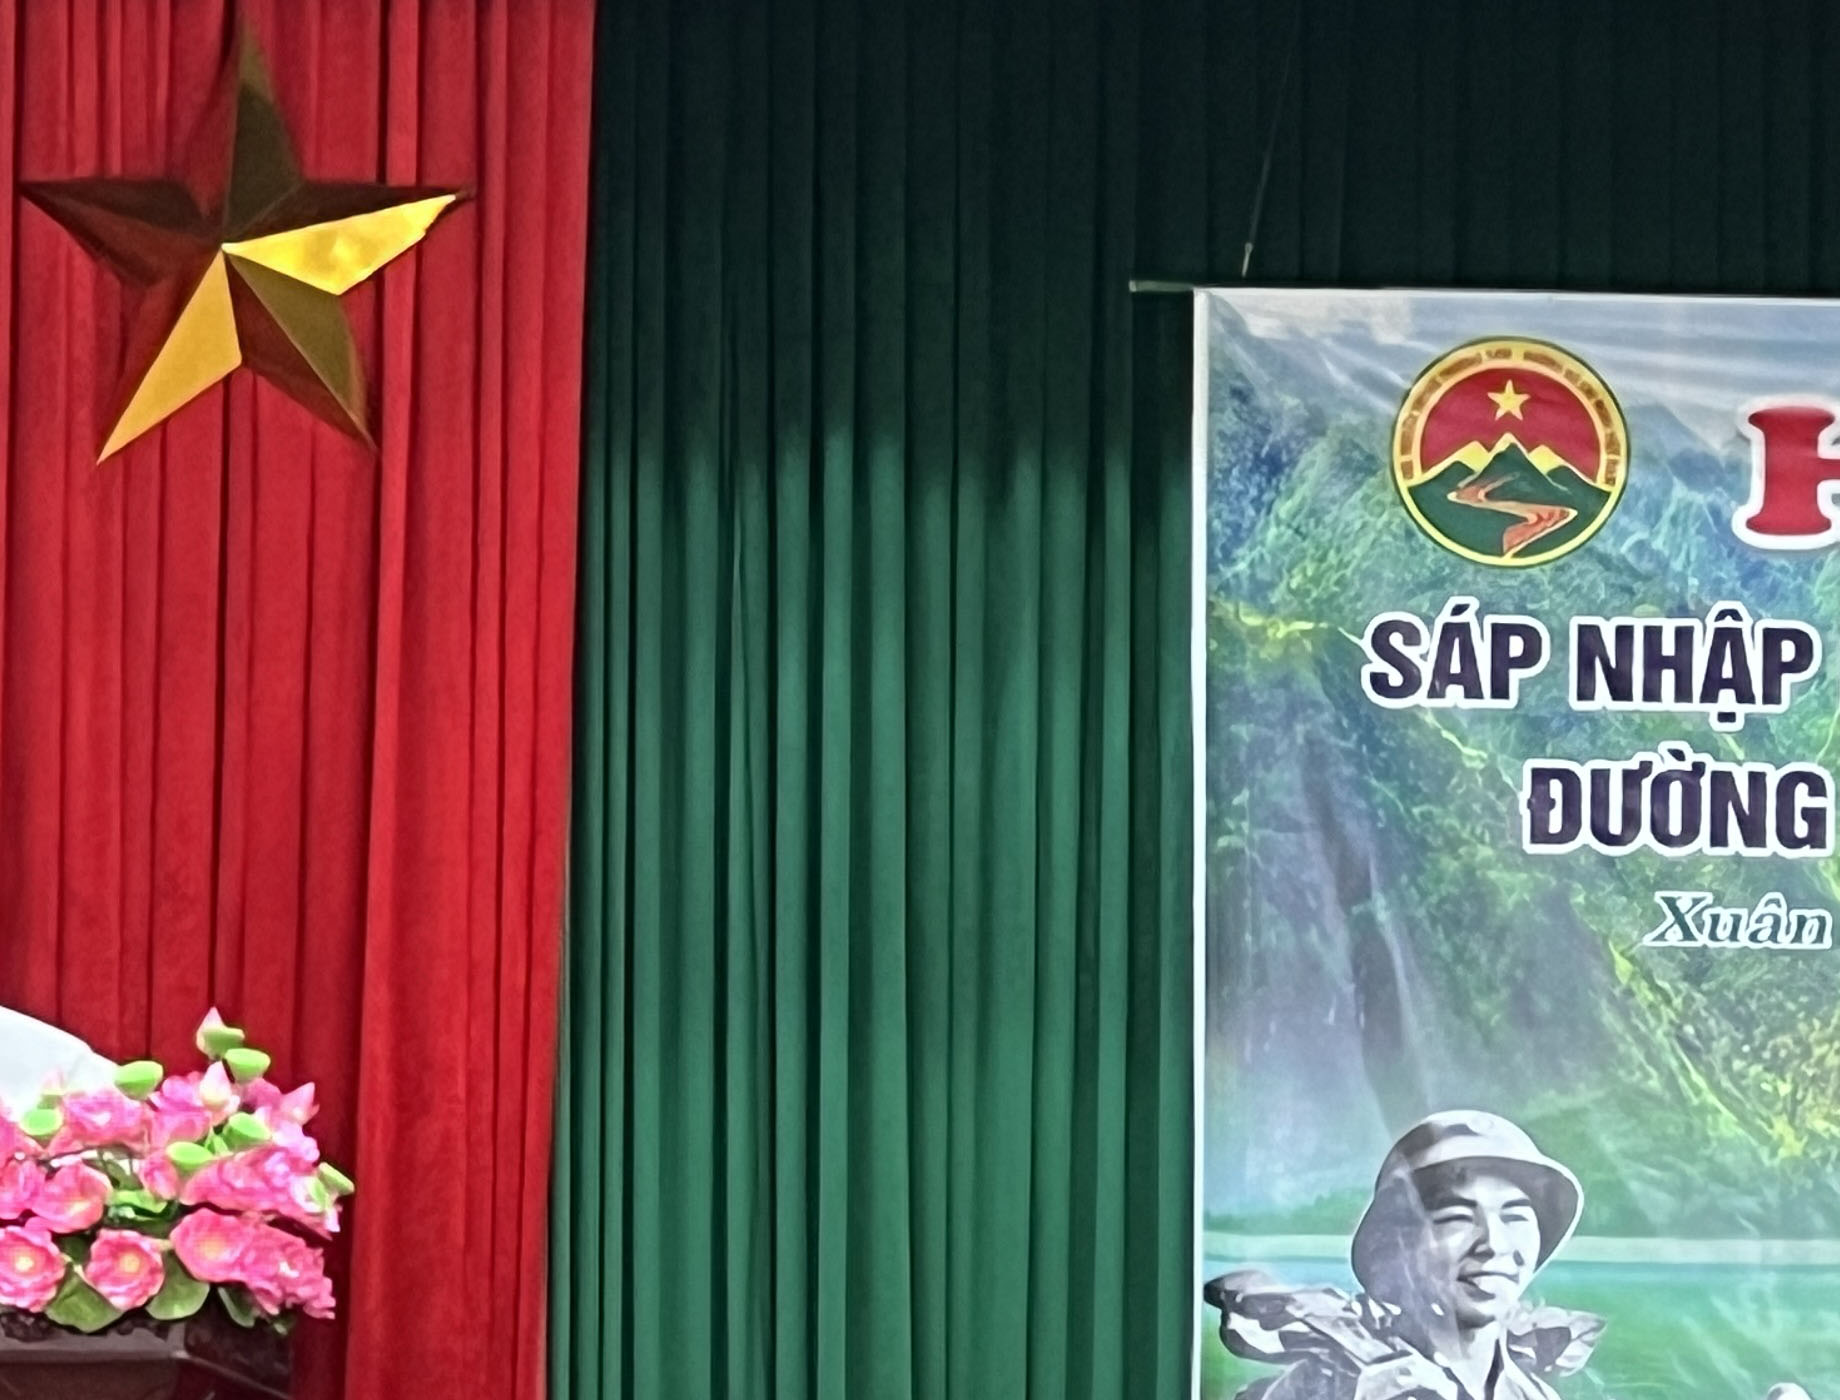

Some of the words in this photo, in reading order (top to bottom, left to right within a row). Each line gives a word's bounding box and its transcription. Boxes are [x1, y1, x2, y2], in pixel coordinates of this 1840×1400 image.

[1368, 603, 1543, 700] SÁP
[1576, 608, 1814, 724] NHẬP
[1527, 748, 1828, 850] ĐƯỜNG
[1650, 894, 1830, 945] Xuân
